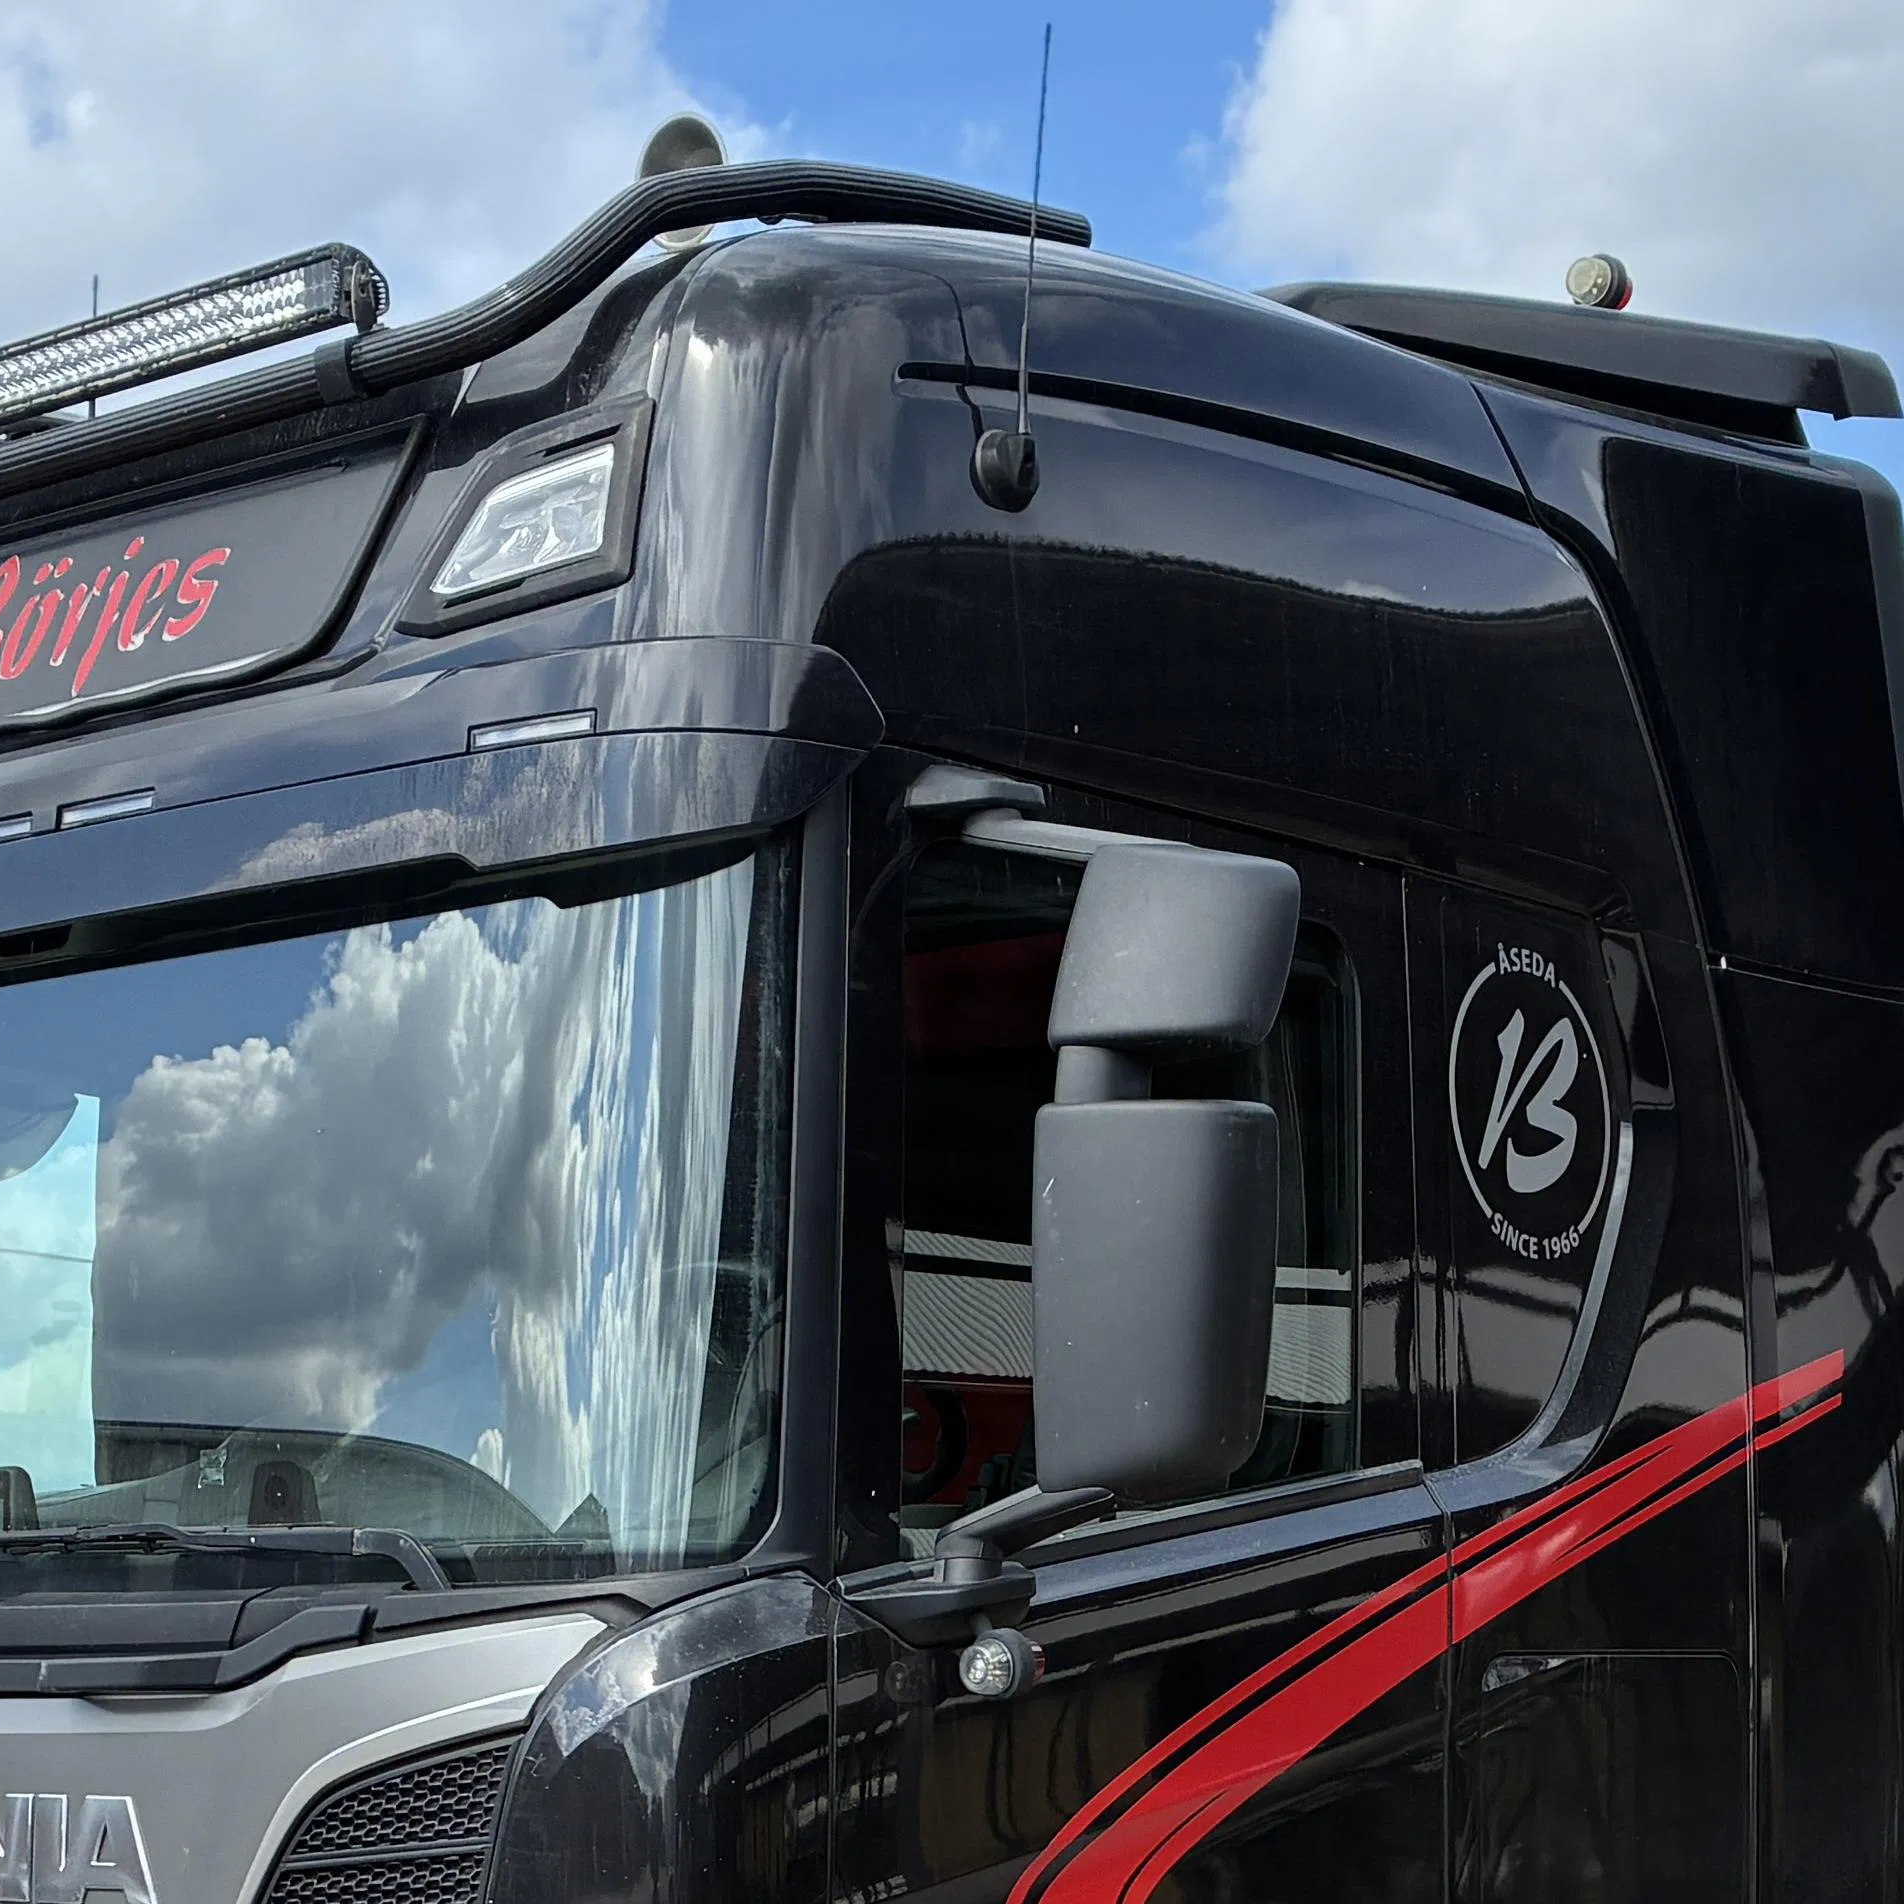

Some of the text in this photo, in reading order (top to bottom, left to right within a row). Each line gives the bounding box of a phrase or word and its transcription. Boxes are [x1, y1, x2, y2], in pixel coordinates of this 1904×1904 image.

[1498, 943, 1557, 988] ÅSEDA
[1491, 1213, 1580, 1259] SINCE 1966
